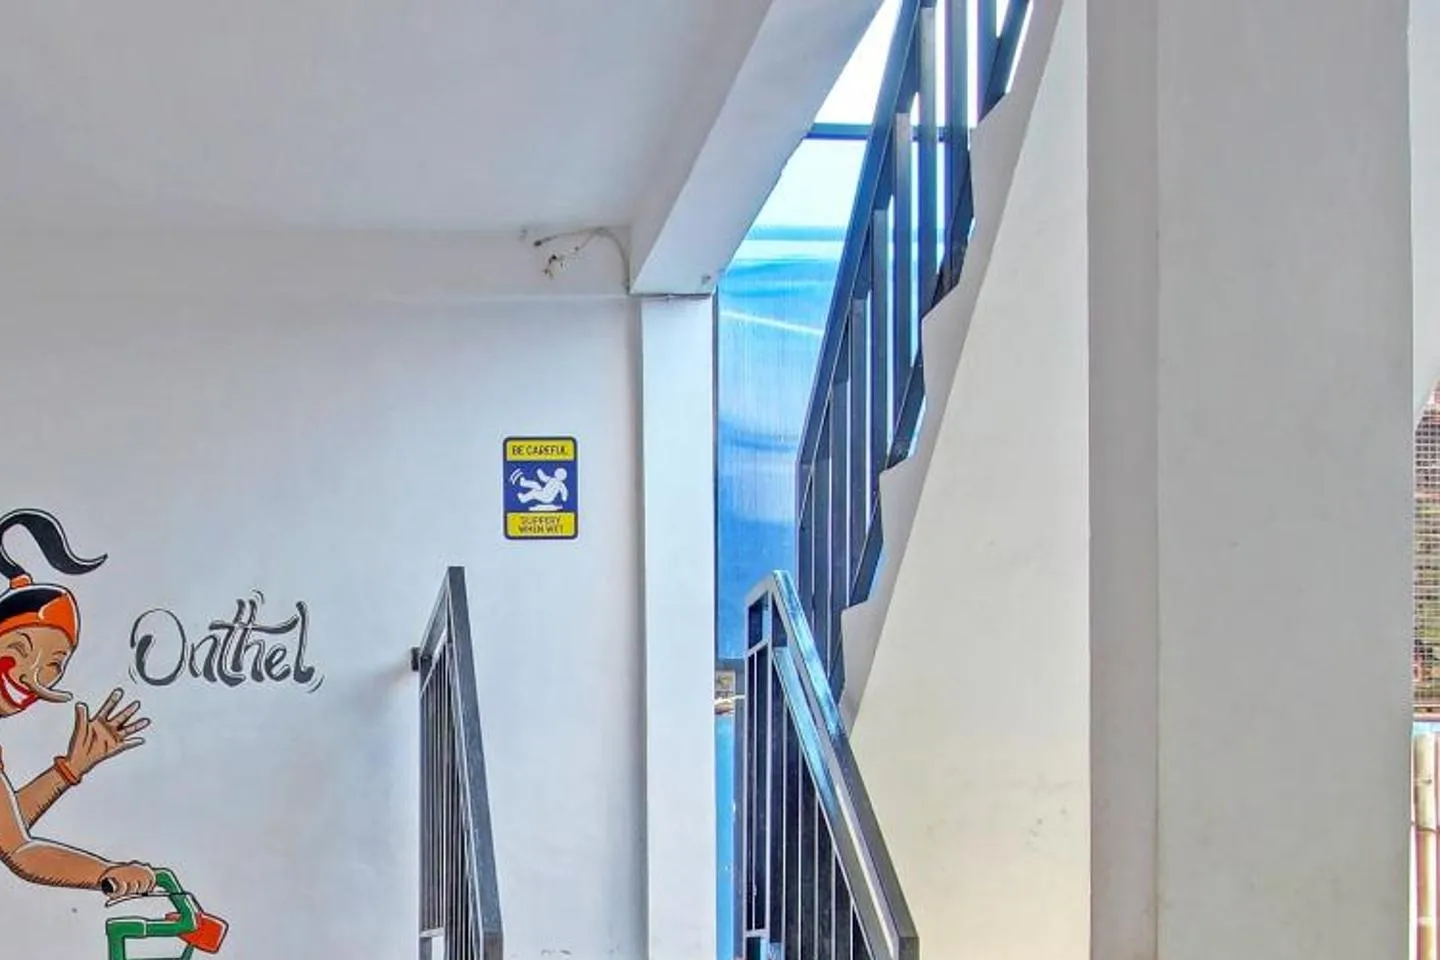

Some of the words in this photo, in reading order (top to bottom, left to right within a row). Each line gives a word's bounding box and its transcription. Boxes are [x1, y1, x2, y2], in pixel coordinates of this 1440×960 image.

[512, 444, 524, 456] BE
[526, 444, 568, 456] CAREFUL
[130, 598, 316, 688] Onthel
